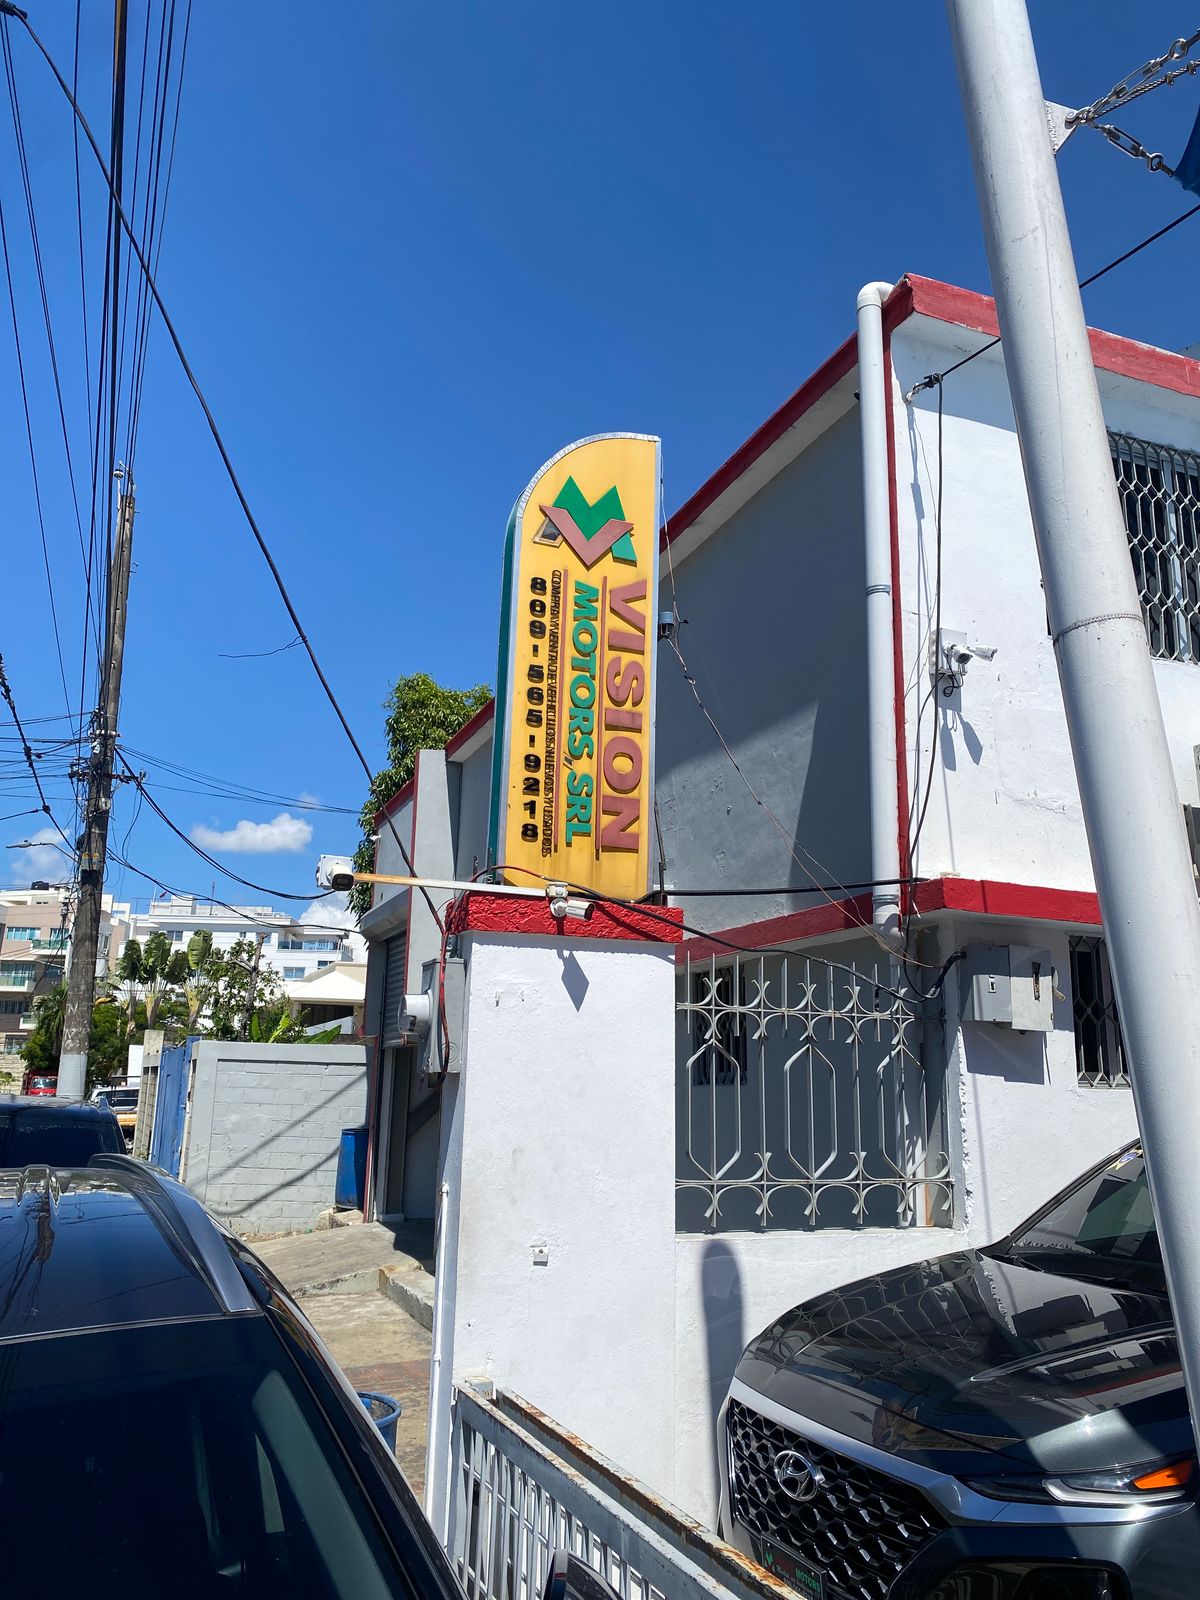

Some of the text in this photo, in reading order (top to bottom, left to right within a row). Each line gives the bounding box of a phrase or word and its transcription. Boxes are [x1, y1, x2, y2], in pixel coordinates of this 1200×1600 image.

[550, 570, 561, 618] COMPRA
[521, 576, 547, 843] 809-565-9218
[601, 579, 647, 852] VISION
[565, 770, 594, 847] SRL
